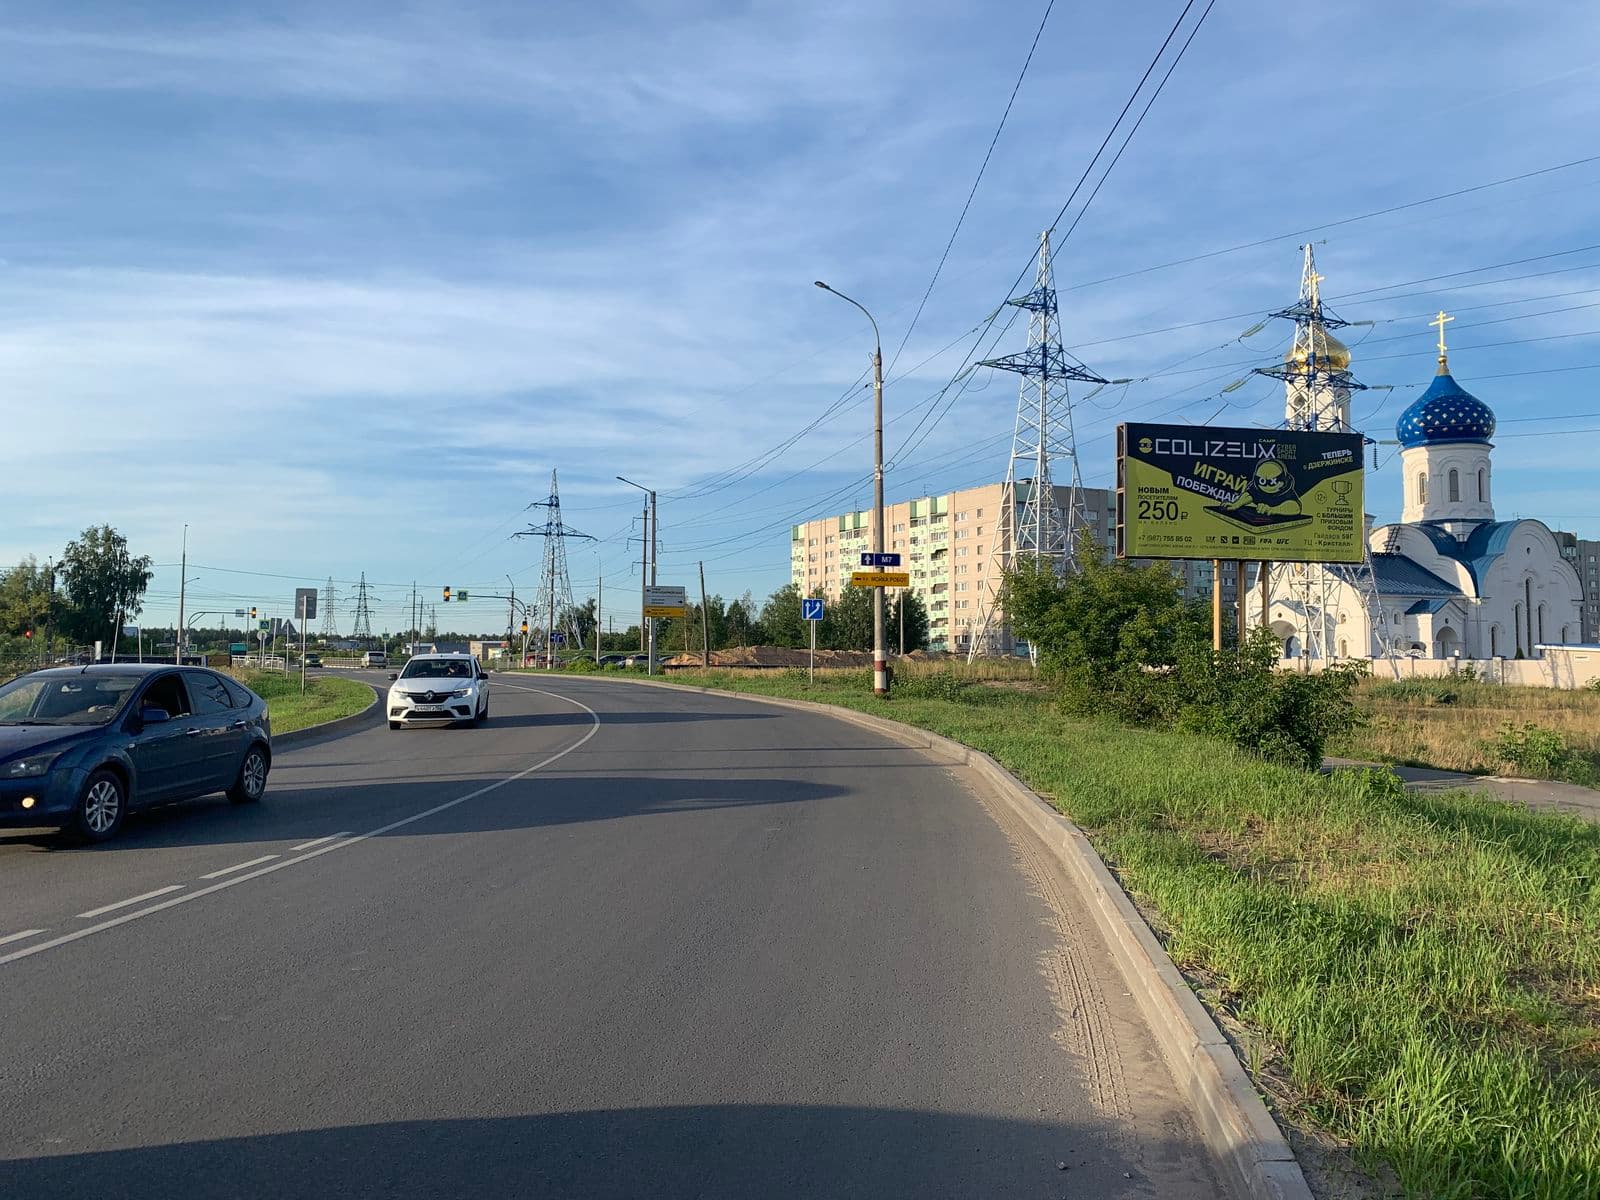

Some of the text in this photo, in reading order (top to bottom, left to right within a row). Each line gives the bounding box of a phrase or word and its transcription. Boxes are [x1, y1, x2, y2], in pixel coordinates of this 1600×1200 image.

[1321, 448, 1353, 460] ТЕПЕРЬ
[1308, 456, 1354, 470] ДЗЕРЖИНСКЕ
[1193, 461, 1248, 493] ИГРАЙ
[1137, 486, 1169, 494] НОВЫМ
[1176, 475, 1240, 502] ПОБЕЖДАЙ
[1138, 500, 1179, 521] 250
